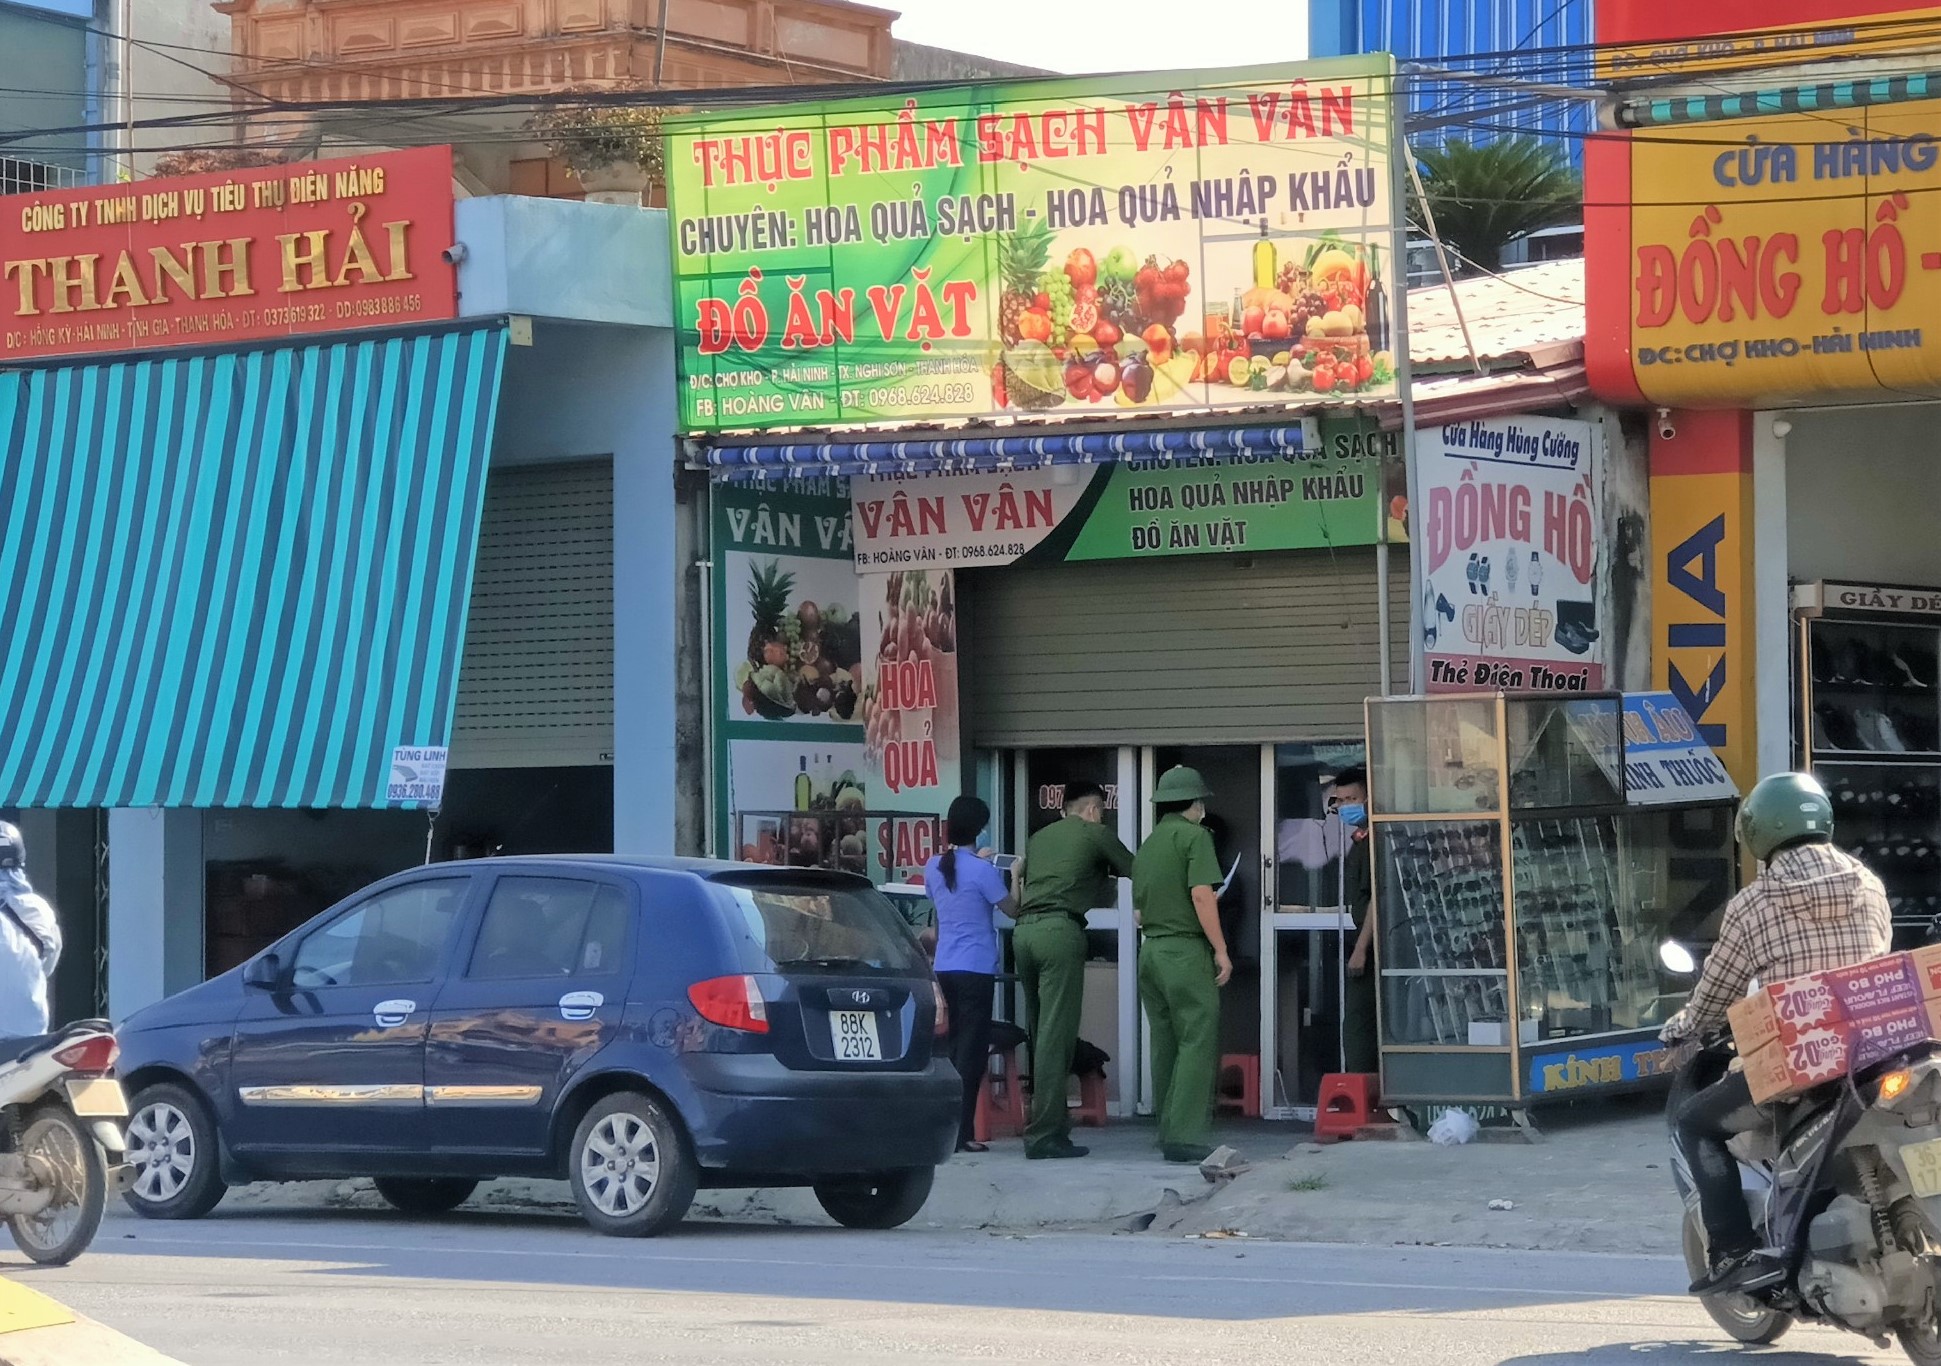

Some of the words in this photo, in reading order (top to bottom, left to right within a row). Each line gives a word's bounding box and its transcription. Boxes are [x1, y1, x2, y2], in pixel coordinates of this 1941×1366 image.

[693, 126, 813, 193] THỰC
[828, 99, 964, 178] PHẨM
[976, 106, 1108, 172] SẠCH
[1125, 89, 1229, 152] VÂN
[1247, 77, 1355, 143] VÂN
[1713, 134, 1797, 187] CỬA
[1813, 125, 1940, 180] HÀNG
[22, 201, 65, 232] CÔNG
[70, 201, 89, 228] TY
[95, 196, 137, 224] TNHH
[143, 191, 179, 224] DỊCH
[184, 189, 205, 220] VỤ
[211, 179, 246, 212] TIÊU
[252, 179, 285, 212] THỤ
[290, 169, 329, 208] ĐIỆN
[336, 165, 385, 199] NĂNG
[680, 205, 797, 256] CHUYÊN:
[805, 204, 863, 246] HOA
[871, 182, 929, 244] QUẢ
[937, 192, 1017, 243] SẠCH
[1047, 187, 1109, 229] HOA
[1118, 165, 1180, 229] QUẢ
[1190, 168, 1277, 225] NHẬP
[1288, 151, 1376, 212] KHẨU
[4, 237, 256, 316] THANH
[275, 201, 414, 293] HẢI
[1635, 204, 1801, 329] ĐỒNG
[1821, 189, 1910, 315] HỒ
[175, 313, 209, 334] THANH
[696, 266, 768, 354] ĐỒ
[780, 274, 855, 349] ĂN
[867, 266, 978, 353] VẶT
[1858, 328, 1921, 351] NINH
[715, 371, 739, 391] CHỢ
[740, 370, 763, 387] KHO
[803, 366, 829, 382] NINH
[855, 361, 881, 379] NGHI
[883, 360, 907, 377] SƠN
[721, 390, 785, 416] HOÀNG
[787, 388, 825, 411] VÂN
[840, 388, 866, 409] ĐT:
[868, 382, 975, 407] 0968.624.828
[1469, 421, 1504, 458] Hàng
[1506, 425, 1540, 462] Hùng
[856, 490, 948, 539] VÂN
[961, 482, 1055, 532] VÂN
[1128, 485, 1174, 512] HOA
[1180, 472, 1227, 511] QUẢ
[1232, 474, 1295, 509] NHẬP
[1302, 464, 1365, 502] KHẨU
[725, 502, 801, 548] VÂN
[1131, 516, 1161, 551] ĐỒ
[1168, 517, 1200, 548] ĂN
[1206, 517, 1248, 552] VẶT
[1427, 461, 1532, 577] ĐỒNG
[1543, 473, 1593, 586] HỒ
[873, 547, 911, 564] HOÀNG
[914, 546, 936, 561] VÂN
[1514, 599, 1554, 648] DÉP
[1668, 512, 1727, 747] KIA
[880, 659, 938, 712] HOA
[1431, 659, 1469, 685] Thẻ
[1473, 661, 1524, 692] Điện
[423, 750, 447, 761] LINH
[883, 719, 939, 794] QUẢ
[1659, 748, 1727, 787] THUỐC
[841, 1013, 868, 1035] 88K
[842, 1037, 875, 1058] 2312
[1542, 1054, 1623, 1092] KÍNH
